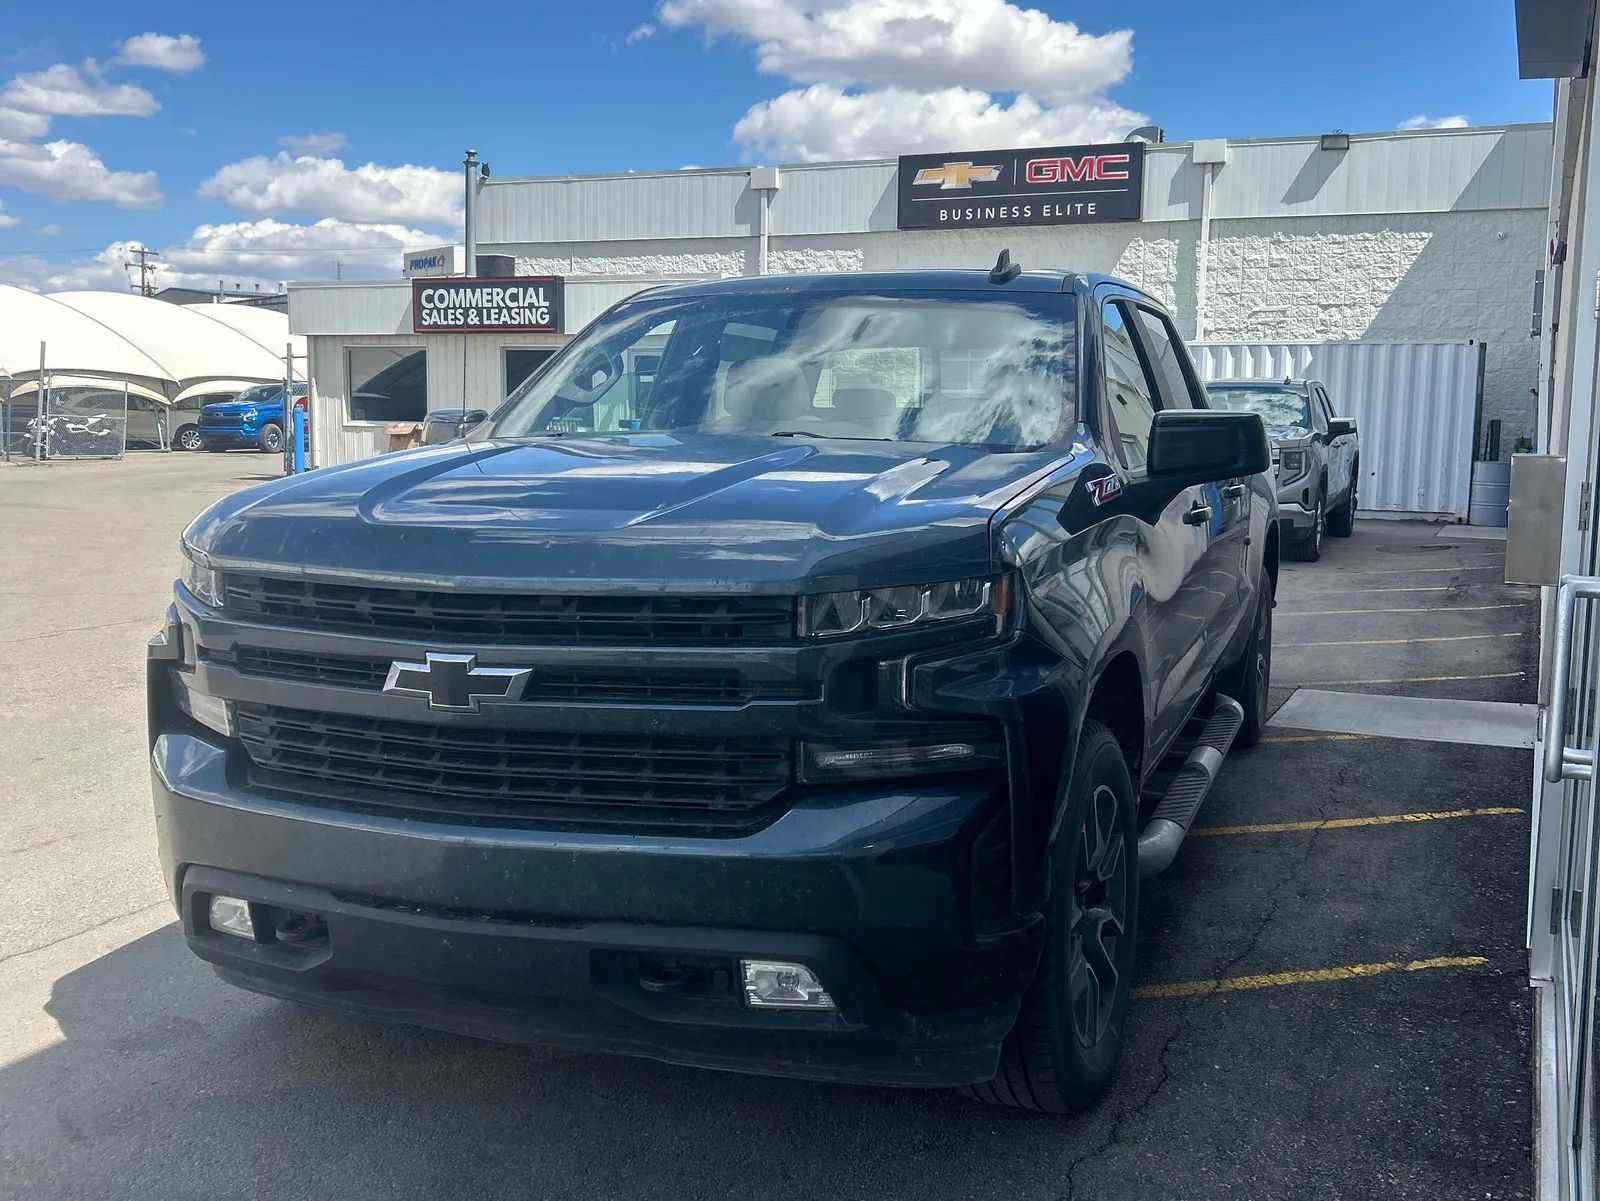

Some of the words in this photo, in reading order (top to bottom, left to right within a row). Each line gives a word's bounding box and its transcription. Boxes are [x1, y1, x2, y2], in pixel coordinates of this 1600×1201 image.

[1025, 154, 1130, 184] GMC
[939, 205, 1032, 221] BUSINESS
[1042, 203, 1097, 217] ELITE
[409, 255, 438, 271] PROPAK
[420, 287, 550, 309] COMMERCIAL
[421, 309, 465, 326] SALES
[467, 309, 481, 325] &
[483, 308, 550, 325] LEASING
